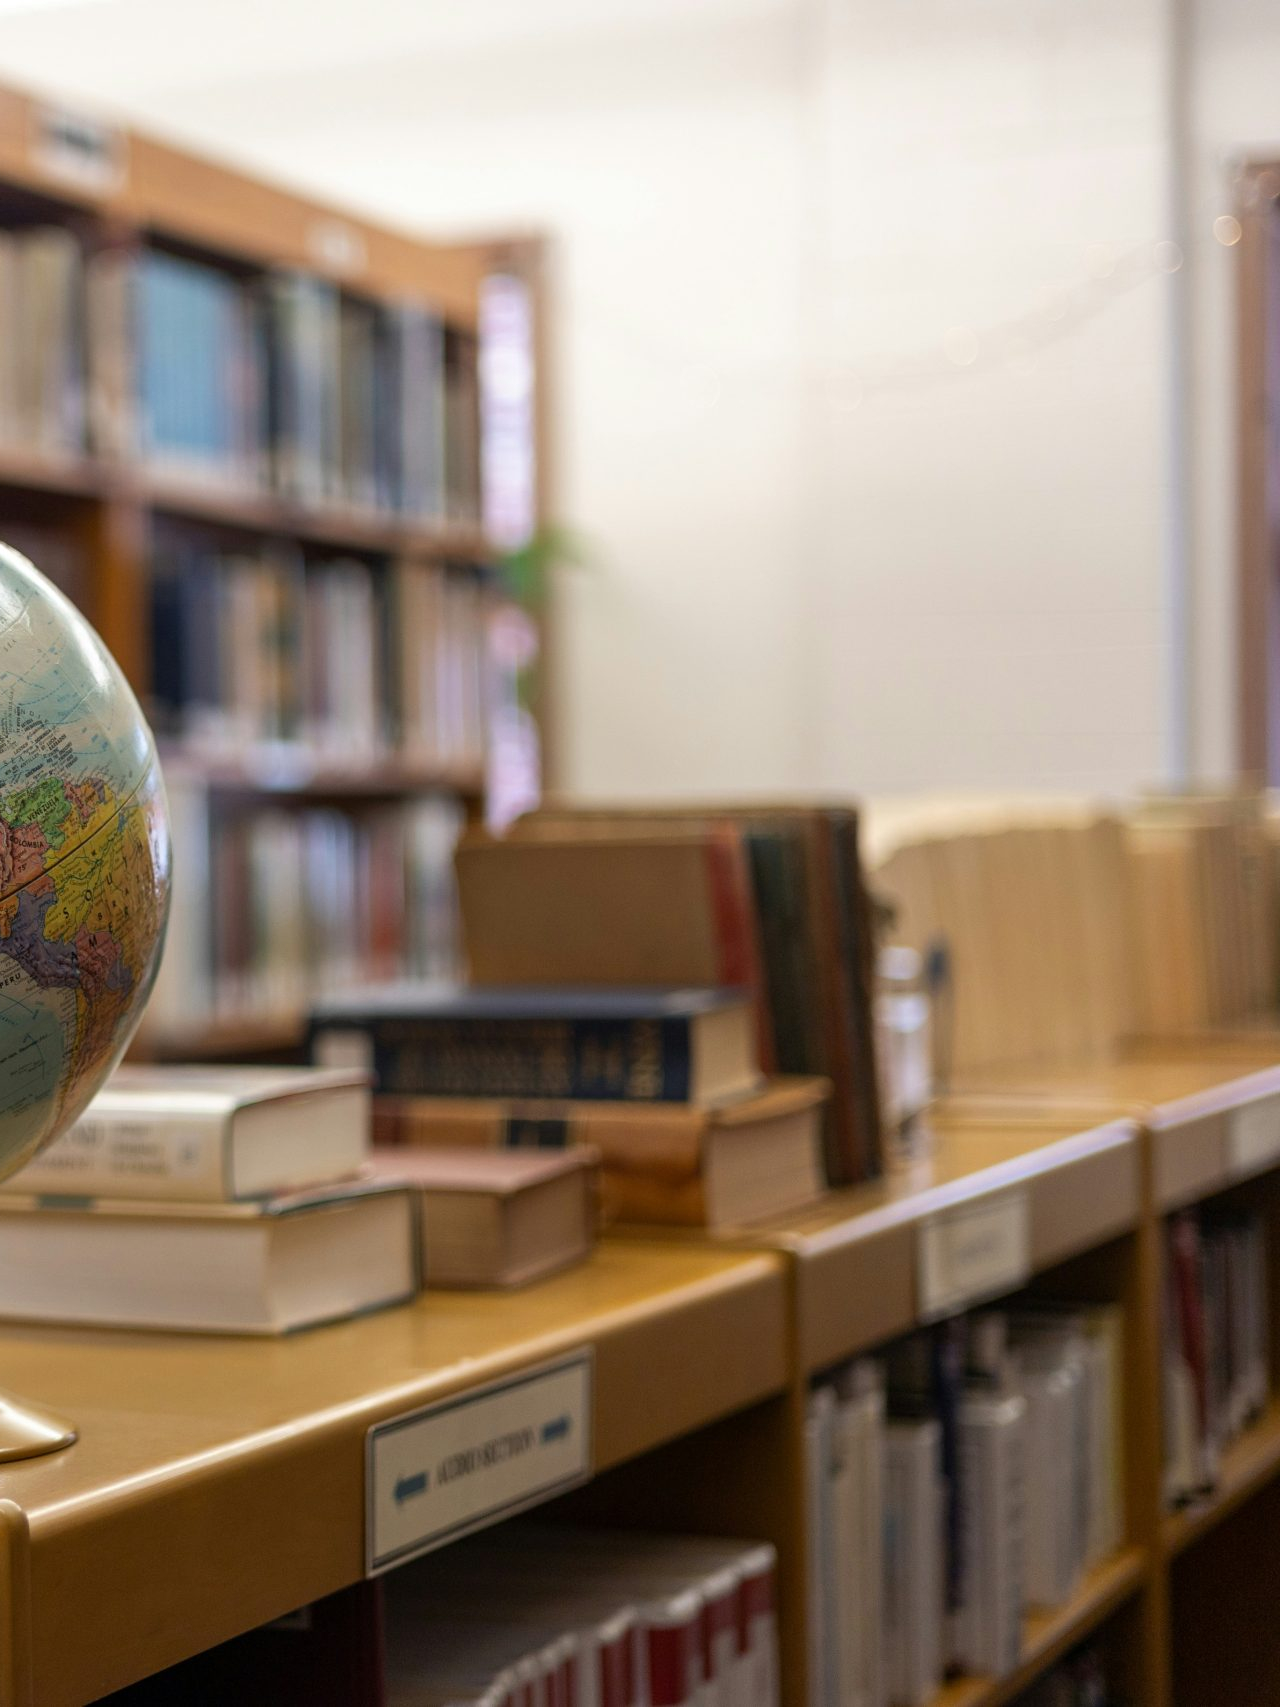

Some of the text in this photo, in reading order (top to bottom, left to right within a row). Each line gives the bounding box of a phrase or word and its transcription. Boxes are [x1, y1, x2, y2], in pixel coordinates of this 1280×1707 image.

[26, 796, 60, 822] VENEZUELA
[9, 834, 45, 849] COLOMBIA
[0, 972, 21, 989] PERU
